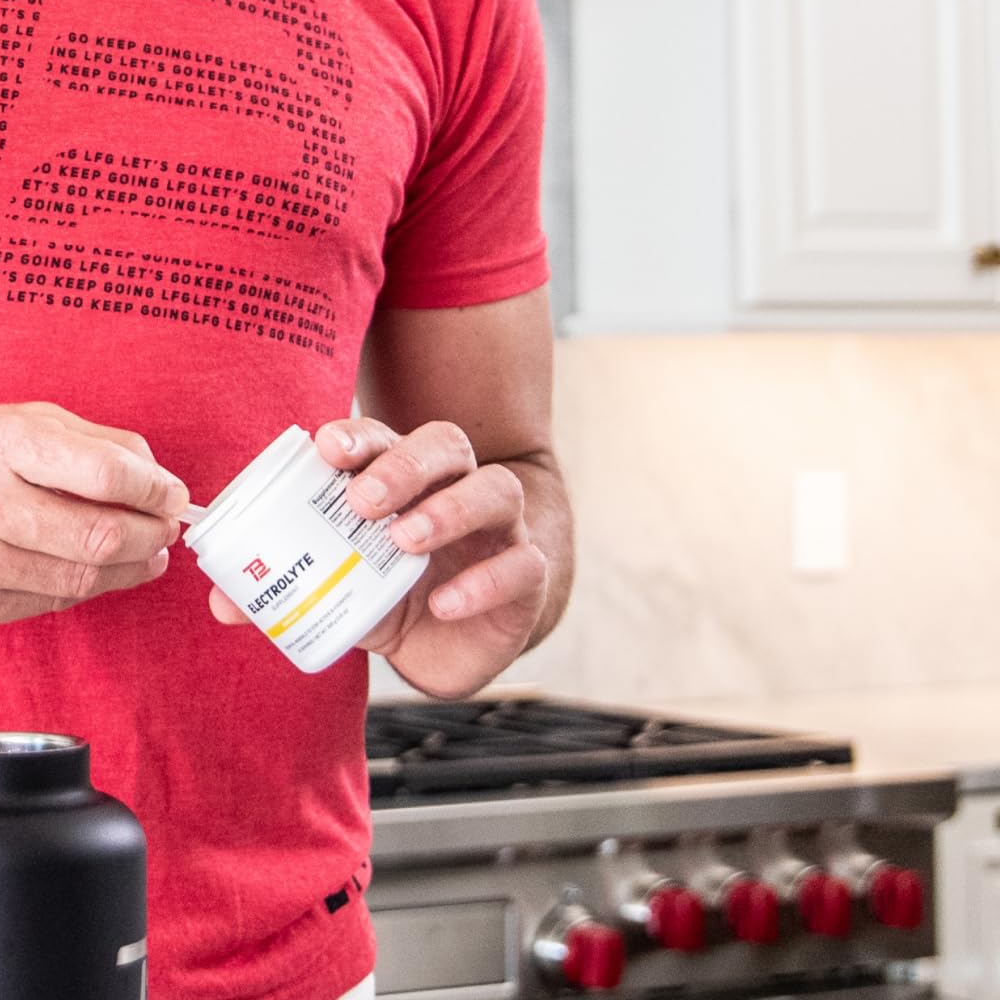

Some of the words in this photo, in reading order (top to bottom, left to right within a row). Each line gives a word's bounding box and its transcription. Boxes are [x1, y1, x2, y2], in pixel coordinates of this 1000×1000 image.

[238, 1, 257, 14] GO
[262, 7, 299, 26] KEEP
[282, 0, 308, 15] LFG
[67, 31, 89, 45] GO
[95, 36, 137, 51] KEEP
[230, 60, 273, 79] LET'S
[296, 33, 332, 51] KEEP
[59, 63, 102, 79] KEEP
[107, 70, 158, 89] GOING
[249, 94, 270, 108] GO
[276, 101, 314, 119] KEEP
[83, 50, 113, 65] LFG
[119, 55, 166, 73] LET'S
[243, 77, 290, 98] GOING
[295, 92, 322, 108] LFG
[311, 67, 353, 89] GOING
[286, 119, 306, 133] GO
[311, 126, 346, 145] KEEP
[303, 139, 329, 156] LFG
[58, 164, 102, 181] KEEP
[107, 171, 160, 190] GOING
[254, 192, 276, 208] GO
[280, 198, 320, 219] KEEP
[83, 150, 114, 166] LFG
[121, 155, 169, 173] LET'S
[251, 174, 300, 196] GOING
[305, 187, 331, 206] LFG
[316, 174, 348, 193] KEEP
[23, 197, 75, 215] GOING
[66, 183, 88, 198] GO
[94, 188, 138, 204] KEEP
[235, 207, 281, 228] LET'S
[285, 219, 306, 234] GO
[20, 253, 73, 270] GOING
[79, 260, 110, 275] LFG
[116, 264, 164, 282] LET'S
[238, 283, 281, 303] GOING
[284, 294, 305, 310] LFG
[24, 272, 47, 286] GO
[53, 275, 97, 292] KEEP
[103, 281, 155, 299] GOING
[240, 302, 260, 317] GO
[263, 307, 295, 325] KEEP
[6, 289, 55, 306] LET'S
[61, 295, 84, 309] GO
[90, 298, 134, 314] KEEP
[225, 317, 265, 337] LET'S
[268, 327, 285, 342] GO
[288, 332, 313, 348] KEEP
[246, 551, 315, 614] ELECTROLYTE
